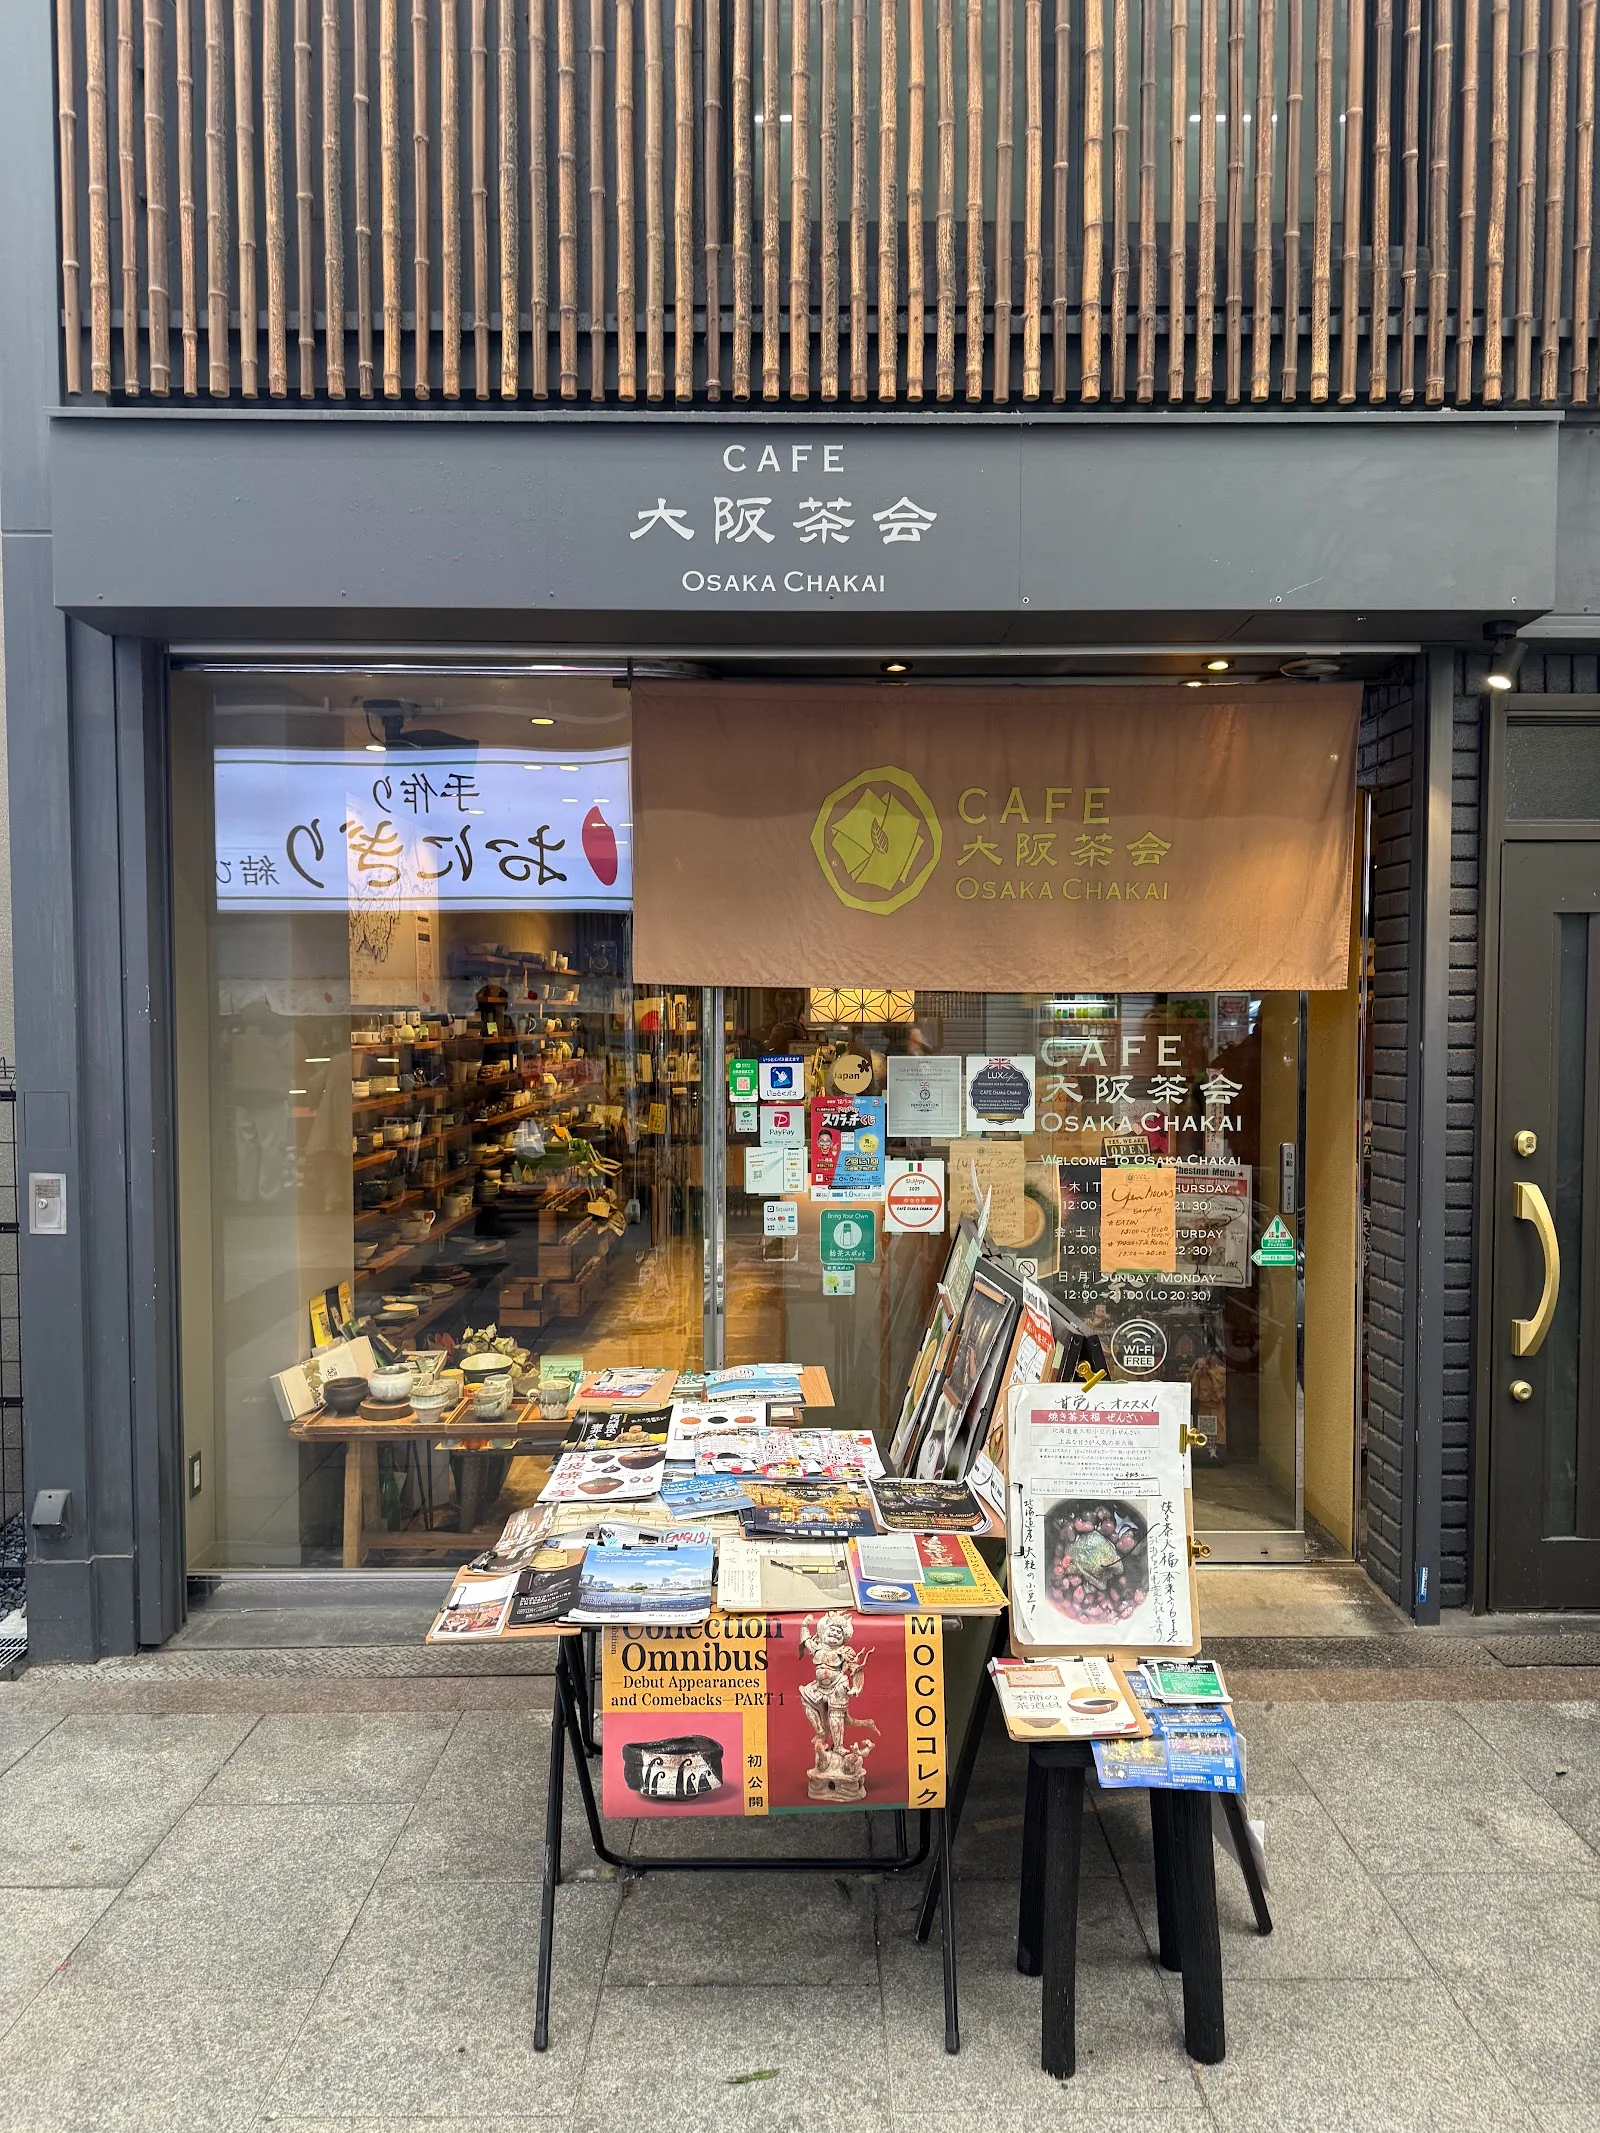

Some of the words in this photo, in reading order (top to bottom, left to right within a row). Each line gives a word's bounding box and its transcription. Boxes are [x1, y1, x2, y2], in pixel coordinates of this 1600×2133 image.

[723, 444, 844, 473] CAFE
[629, 496, 938, 545] 大阪茶会
[957, 786, 1111, 825] CAFE
[956, 831, 1173, 868] 大阪茶会
[1041, 1035, 1182, 1067] CAFE
[833, 1071, 860, 1081] Japan
[1041, 1074, 1243, 1105] 大阪茶会
[821, 1113, 876, 1126] スクラッチくじ
[769, 1129, 795, 1137] PayPay
[1111, 1144, 1145, 1155] OPEN
[1041, 1154, 1107, 1166] WELCOME
[1212, 1168, 1236, 1178] Menu
[1175, 1184, 1230, 1193] HURSDAY
[1063, 1201, 1097, 1210] 12:00
[827, 1212, 841, 1220] Bring
[1175, 1229, 1223, 1239] TURDAY
[1063, 1245, 1097, 1255] 12:00
[1160, 1273, 1217, 1283] MONDAY
[1123, 1345, 1155, 1354] WI-FI
[1126, 1357, 1153, 1365] FREE
[1047, 1412, 1101, 1422] 焼き茶大福
[1105, 1412, 1144, 1423] ぜんざい
[622, 1642, 769, 1672] Omnibus
[668, 1675, 760, 1691] Appearances
[612, 1693, 637, 1706] and
[747, 1754, 764, 1808] 初公開
